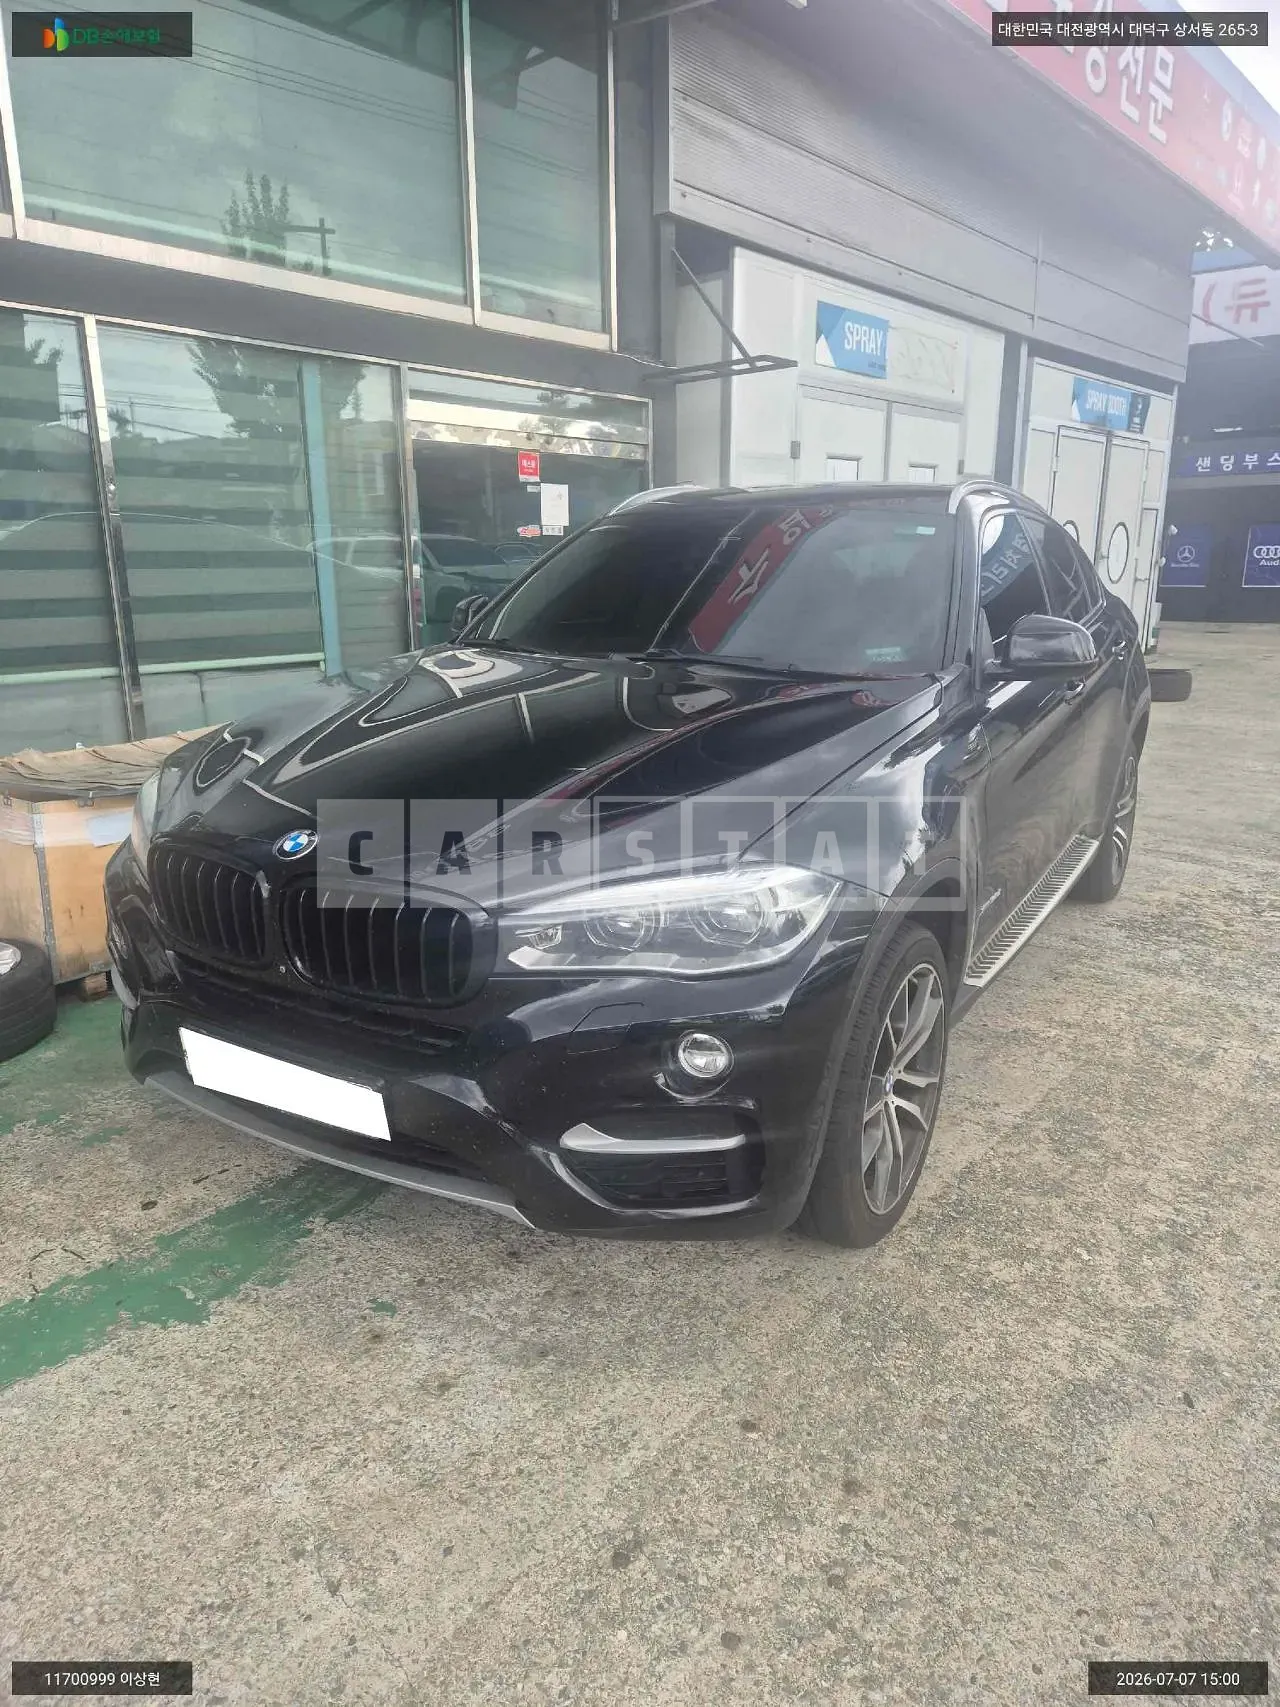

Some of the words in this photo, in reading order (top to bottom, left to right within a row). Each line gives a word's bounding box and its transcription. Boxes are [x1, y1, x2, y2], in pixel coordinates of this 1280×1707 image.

[844, 320, 883, 357] SPRAY
[1085, 389, 1108, 412] SPRAY
[1259, 559, 1280, 567] Aud
